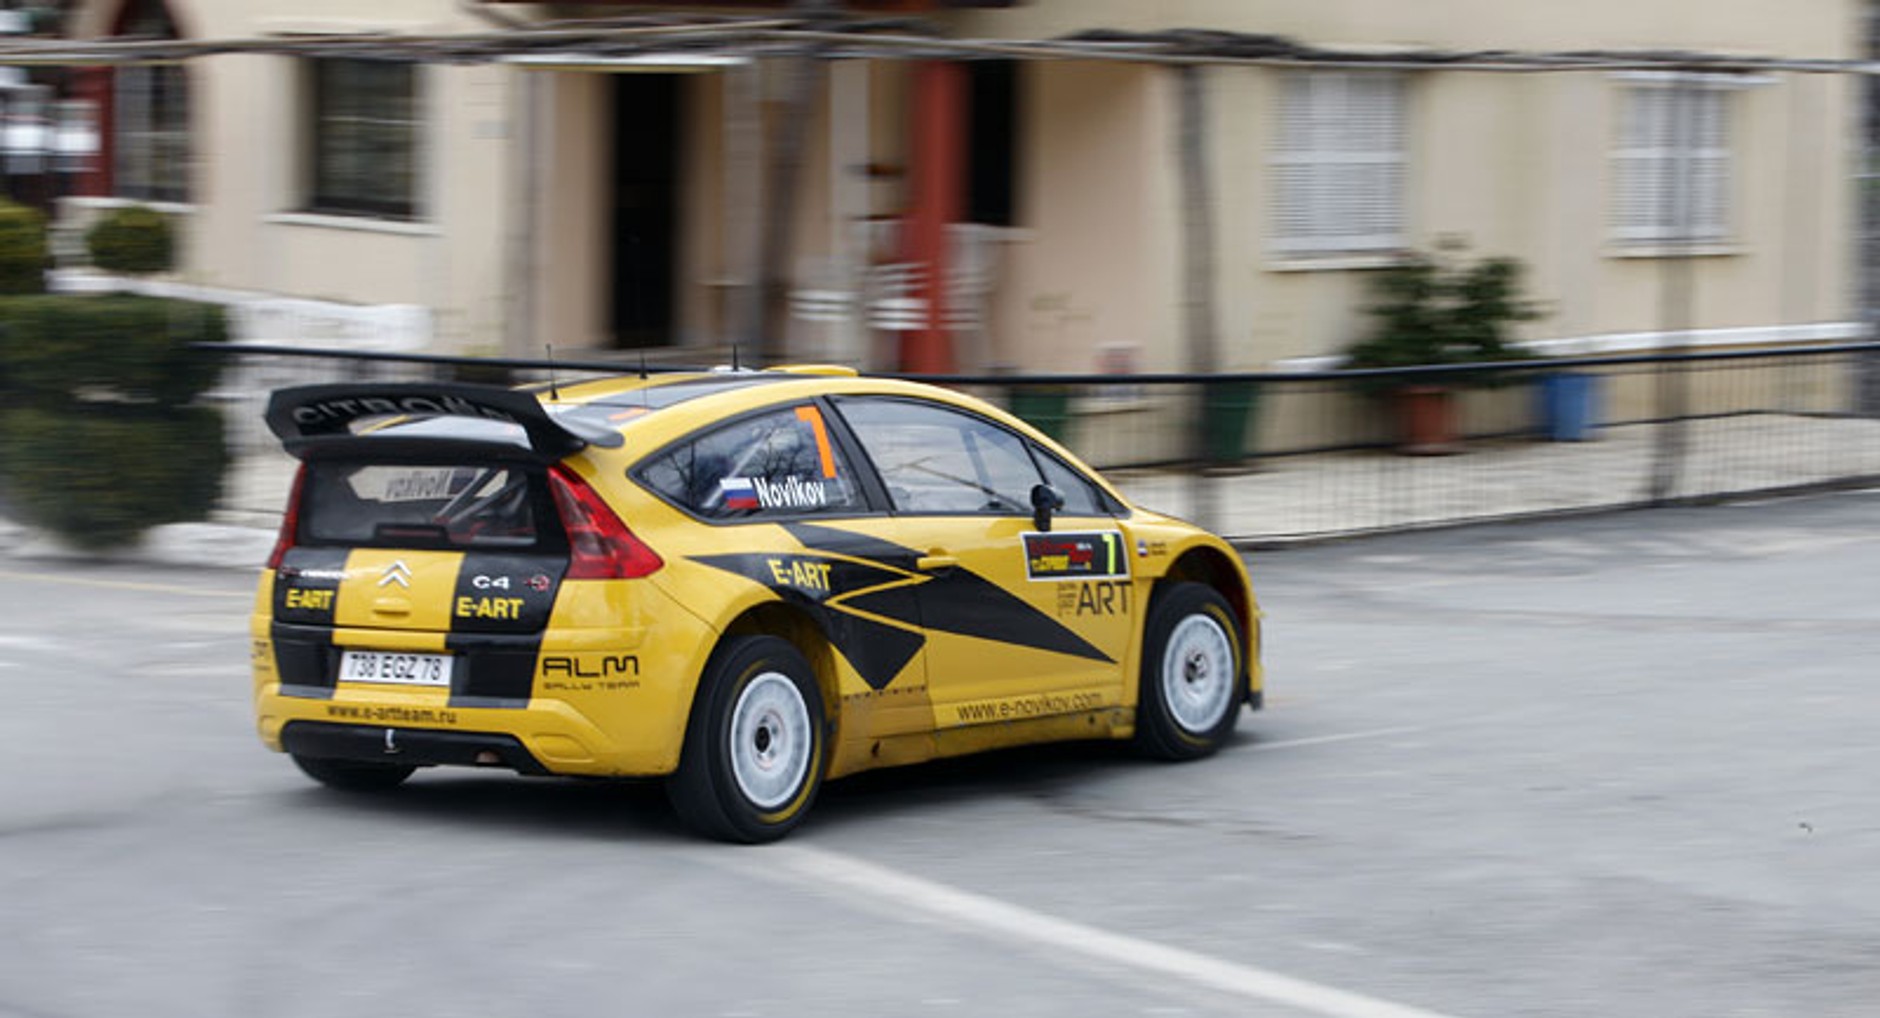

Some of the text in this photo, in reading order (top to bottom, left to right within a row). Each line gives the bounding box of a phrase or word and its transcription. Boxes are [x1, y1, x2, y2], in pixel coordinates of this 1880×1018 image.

[753, 475, 826, 507] Novikov
[472, 575, 510, 590] C4
[767, 558, 831, 591] E-ART
[286, 588, 334, 610] E-ART
[456, 597, 524, 619] E-ART
[1077, 581, 1133, 614] ART
[350, 653, 442, 681] 738 EGZ 78
[543, 655, 639, 678] ALM
